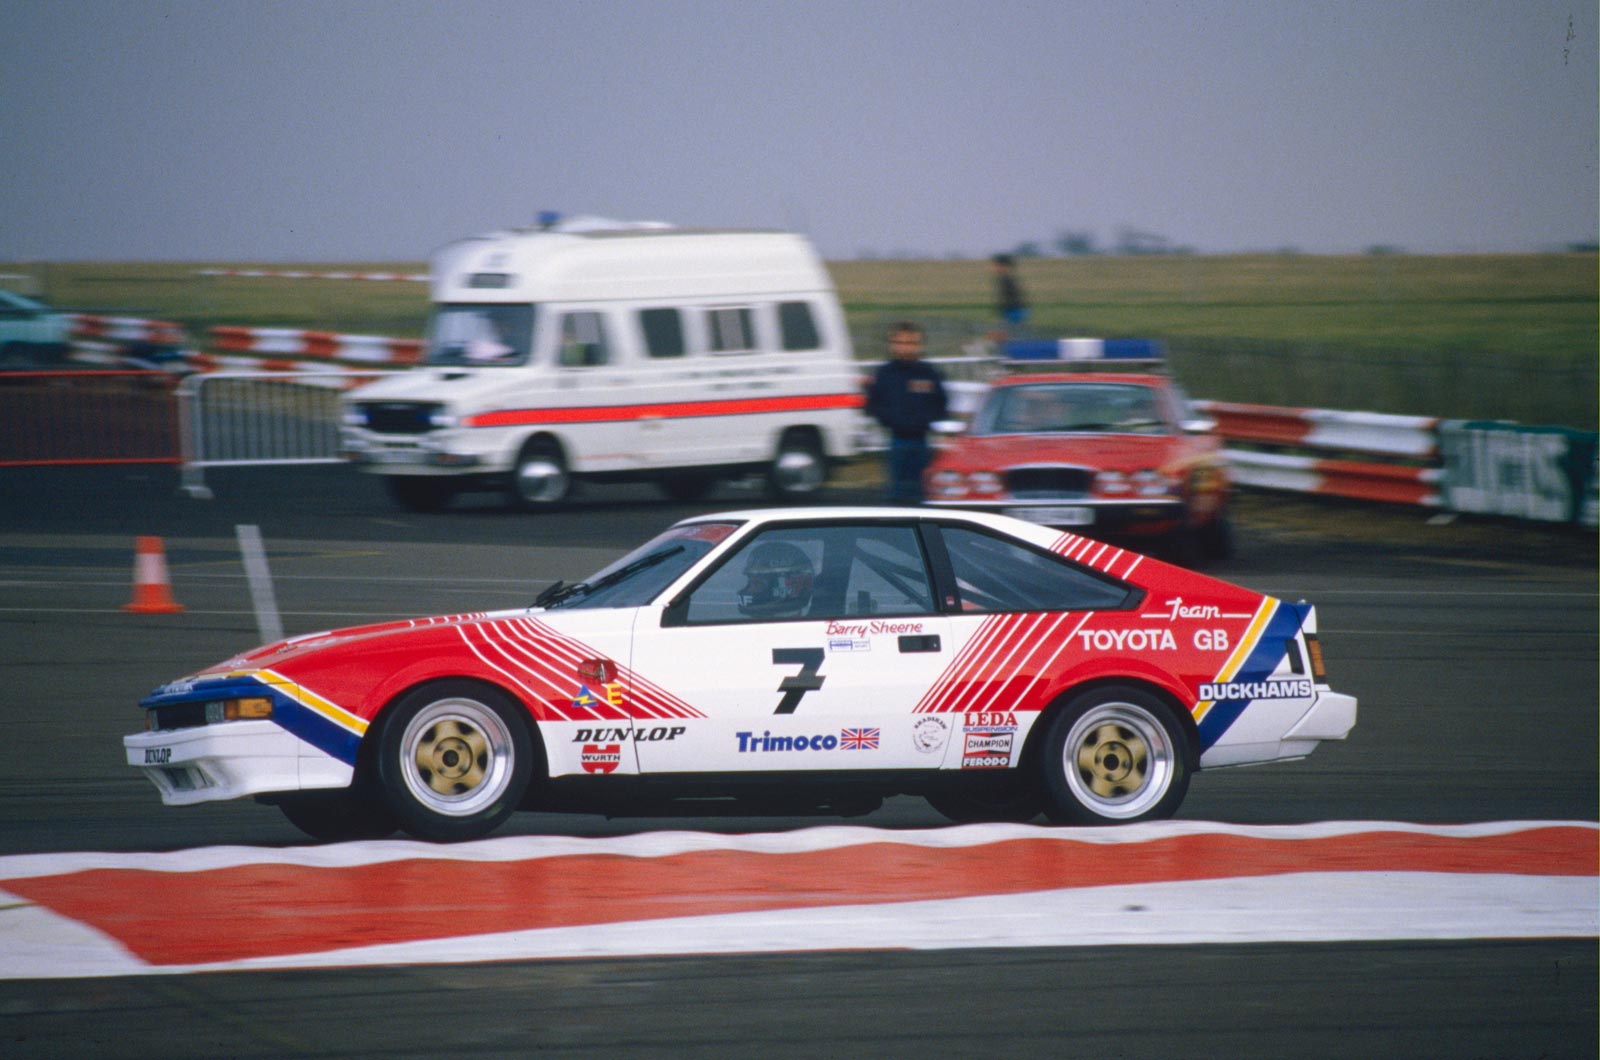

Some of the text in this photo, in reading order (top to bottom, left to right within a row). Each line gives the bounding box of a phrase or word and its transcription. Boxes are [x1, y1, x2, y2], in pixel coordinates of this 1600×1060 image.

[1165, 597, 1221, 621] Team
[826, 620, 922, 638] Barry Sheene
[1077, 629, 1229, 650] TOYOTA GB
[772, 647, 826, 714] 7
[606, 683, 623, 705] E
[1200, 681, 1312, 700] DUCKHAMS
[963, 712, 1018, 726] LEDA
[572, 726, 686, 743] DUNLOP
[736, 730, 838, 752] Trimoco
[968, 739, 1010, 748] CHAMPION
[145, 748, 171, 763] DUNLOP
[964, 756, 1008, 766] FERODO
